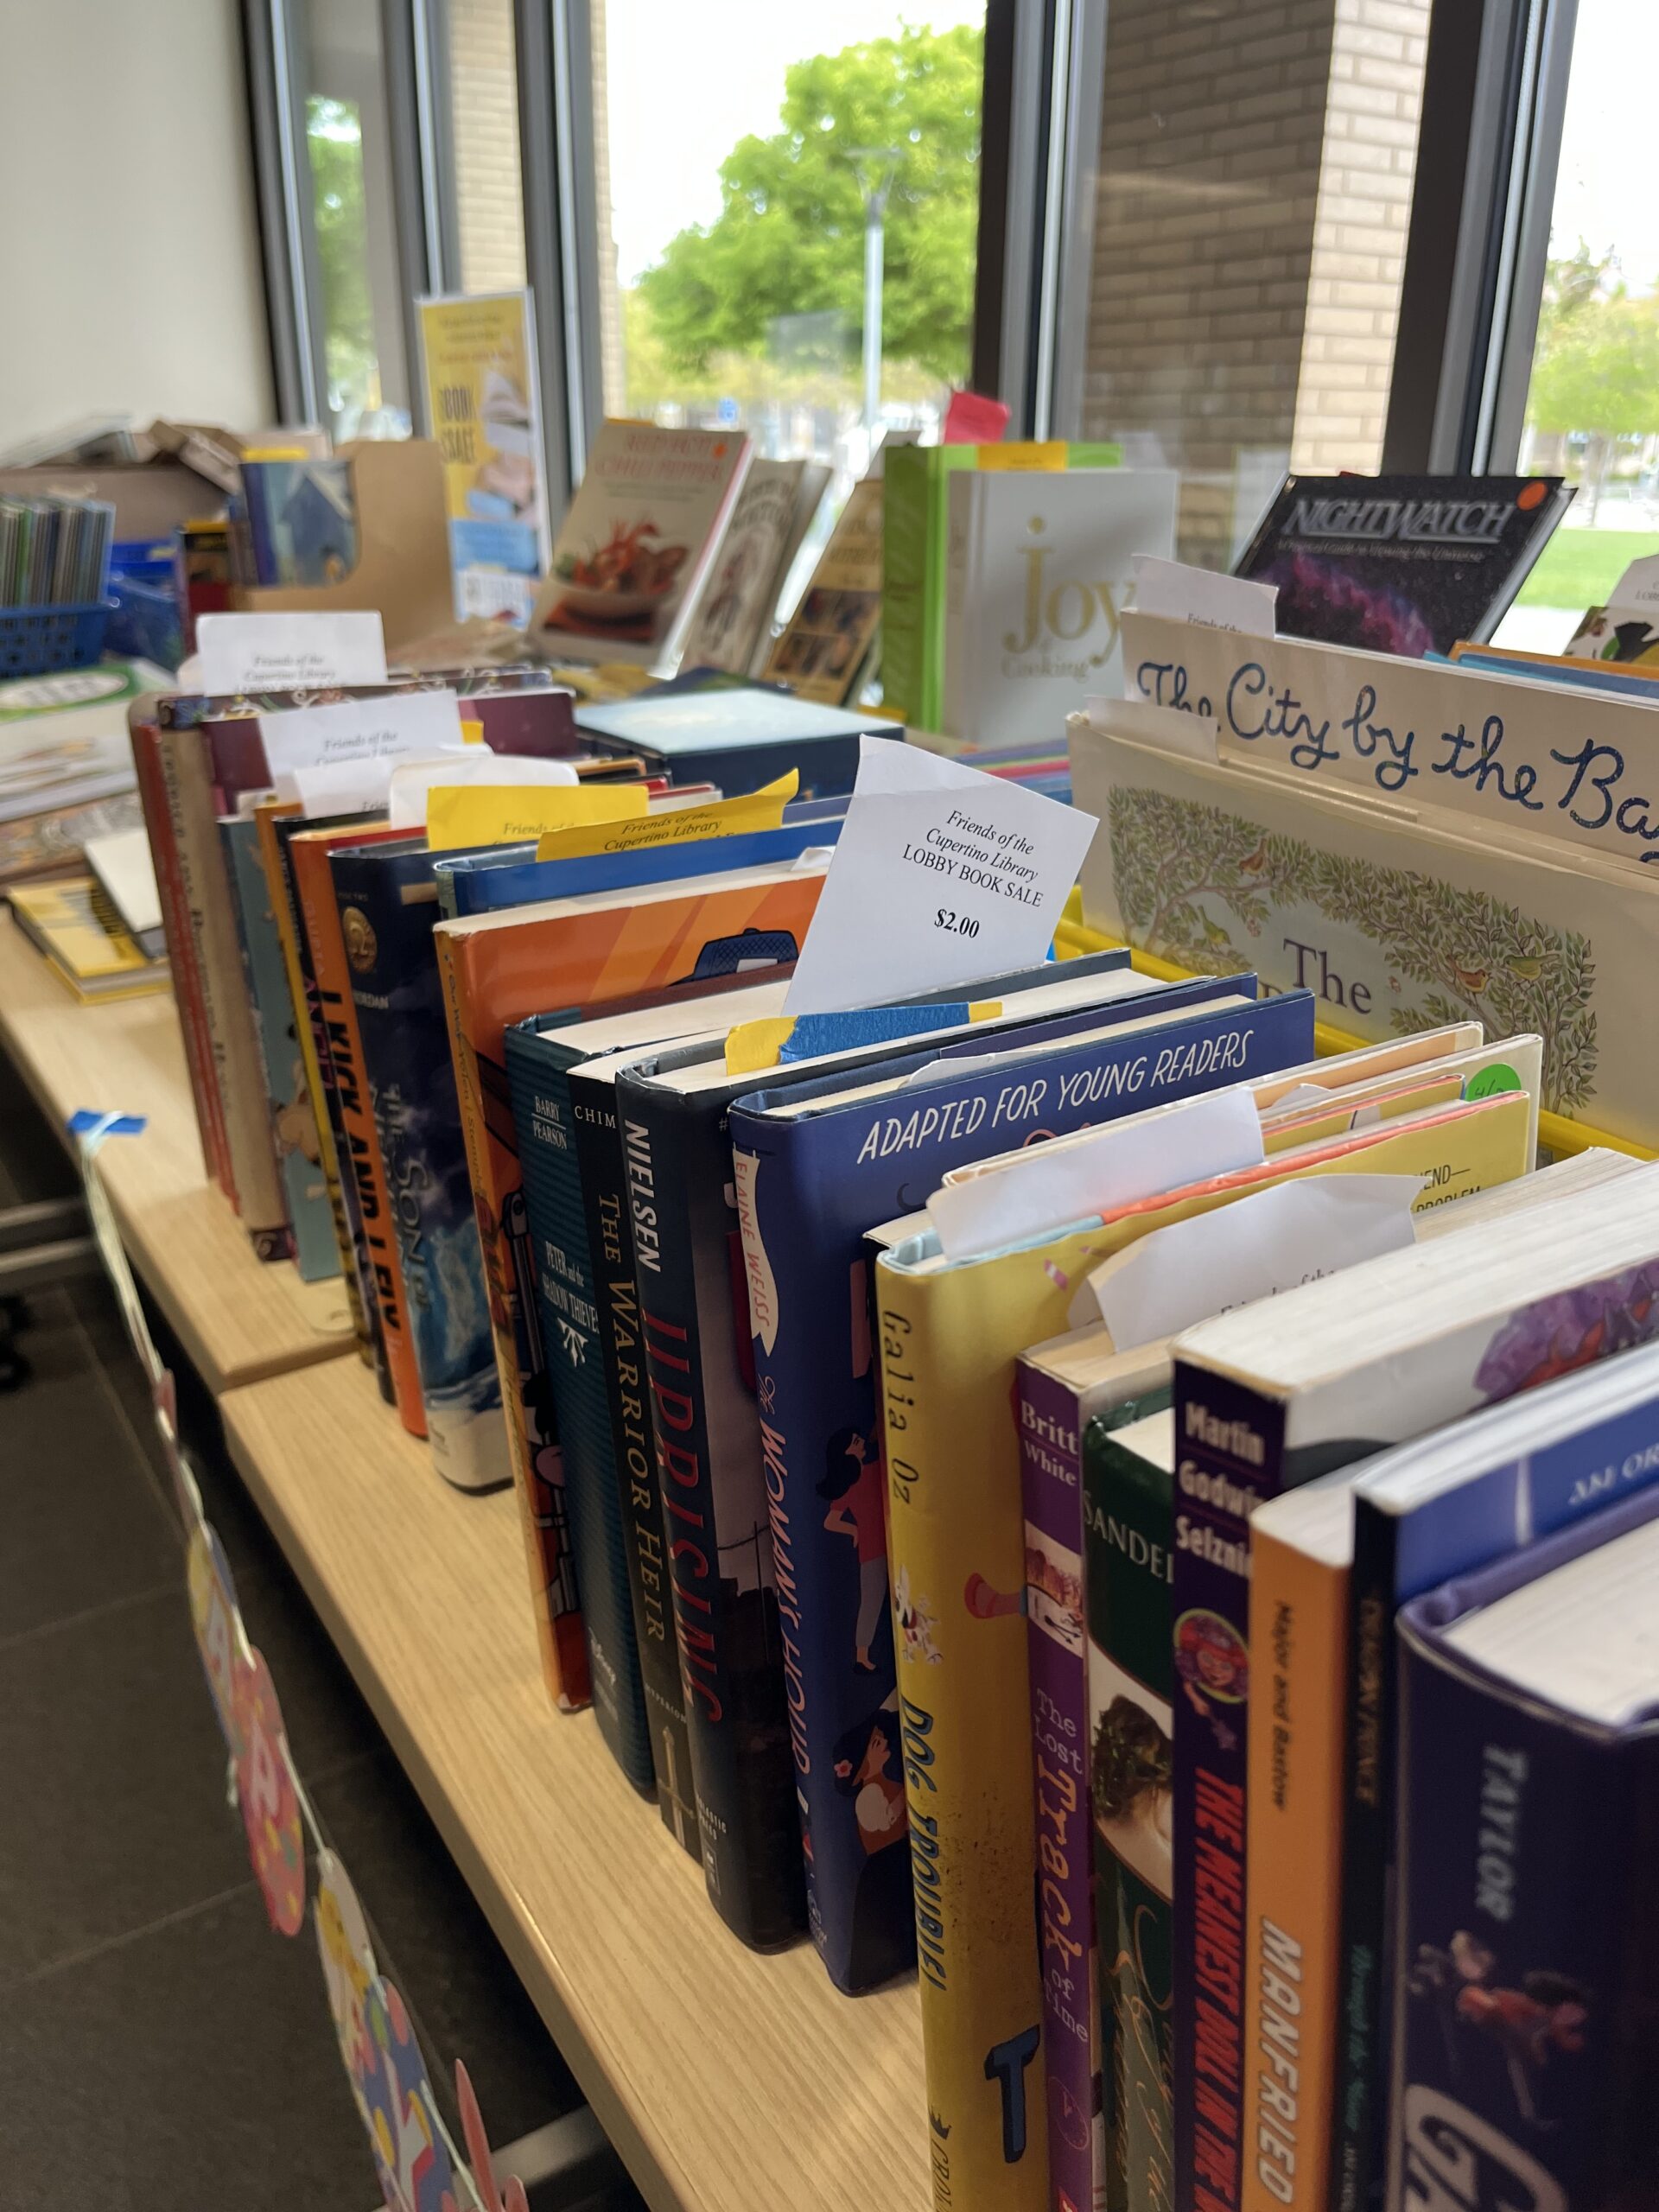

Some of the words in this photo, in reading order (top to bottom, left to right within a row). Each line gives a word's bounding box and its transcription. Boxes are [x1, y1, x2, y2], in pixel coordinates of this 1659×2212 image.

[1281, 499, 1514, 542] NIGHTWATCH
[324, 735, 367, 751] Friends
[1225, 662, 1340, 770] City
[1343, 685, 1419, 791] by
[1432, 715, 1544, 810] the
[1550, 739, 1659, 839] Ba
[604, 831, 671, 852] Cupertino
[671, 820, 723, 839] Library
[621, 817, 671, 836] Friends
[926, 828, 988, 862] Cupertino
[990, 853, 1039, 883] Library
[946, 810, 996, 842] Friends
[998, 834, 1018, 849] of
[1014, 837, 1034, 855] the
[902, 843, 958, 875] LOBBY
[958, 865, 1004, 893] BOOK
[1004, 882, 1044, 907] SALE
[934, 909, 980, 938] $2.00
[1283, 938, 1372, 1015] The
[324, 1020, 363, 1117] KICK
[856, 1096, 987, 1165] ADAPTED
[992, 1078, 1047, 1128] FOR
[1058, 1056, 1146, 1111] YOUNG
[1150, 1029, 1255, 1088] READERS
[532, 1122, 568, 1151] PEARSON
[535, 1095, 560, 1122] BARRY
[575, 1105, 617, 1128] CHIM
[396, 1154, 429, 1266] SON
[599, 1193, 620, 1264] THE
[624, 1119, 662, 1273] NIELSEN
[545, 1240, 569, 1277] PETER
[734, 1161, 755, 1242] ELAINE
[747, 1251, 770, 1327] WEISS
[607, 1279, 652, 1510] WARRIOR
[882, 1309, 915, 1431] Galia
[1021, 1399, 1079, 1456] Britt
[1185, 1400, 1266, 1466] Martin
[893, 1458, 919, 1504] Oz
[1025, 1440, 1077, 1487] White
[760, 1416, 800, 1631] WOMAN'S
[1175, 1515, 1249, 1579] Selzni
[636, 1522, 665, 1642] HEIR
[779, 1629, 810, 1776] HOUR
[1036, 1688, 1077, 1738] The
[901, 1693, 938, 1793] DOG
[1036, 1719, 1084, 1776] Lost
[1195, 1767, 1245, 1853] THE
[1476, 1743, 1529, 1924] TAYLOR
[1038, 1755, 1083, 1972] Track
[1195, 1837, 1243, 2016] MEANEST
[1052, 1967, 1076, 2002] of
[1194, 1993, 1242, 2094] DOLL
[1258, 1914, 1302, 2205] MANFRIED
[1194, 2077, 1240, 2127] IN
[1193, 2124, 1238, 2205] THE
